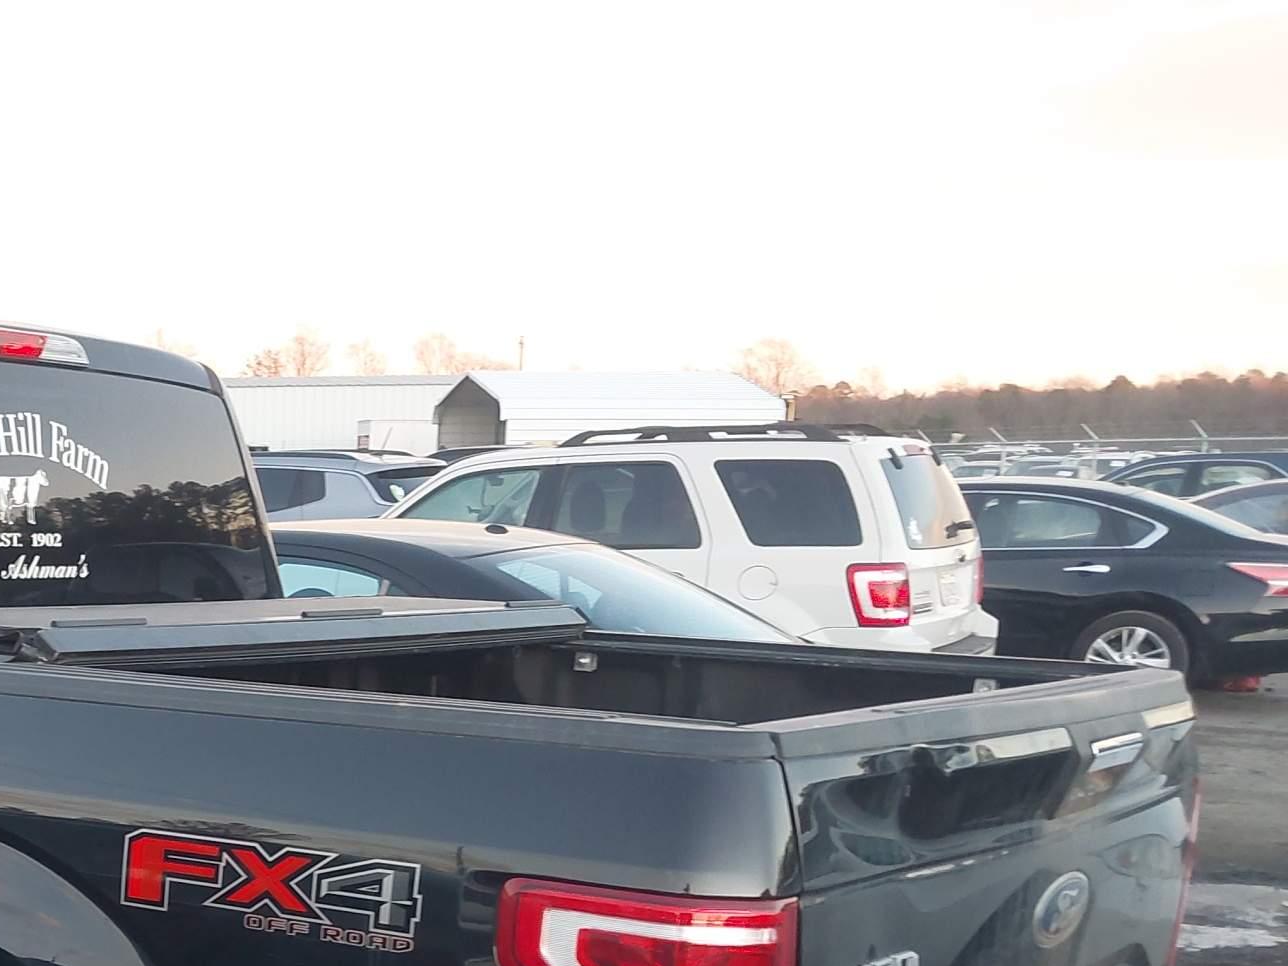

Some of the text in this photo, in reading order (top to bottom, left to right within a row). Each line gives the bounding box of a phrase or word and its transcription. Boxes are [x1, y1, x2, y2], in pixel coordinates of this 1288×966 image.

[49, 420, 110, 490] Farm
[31, 533, 62, 547] 1902
[1, 554, 89, 579] Ashman's
[120, 828, 422, 937] FX4
[244, 914, 414, 953] OFF ROAD
